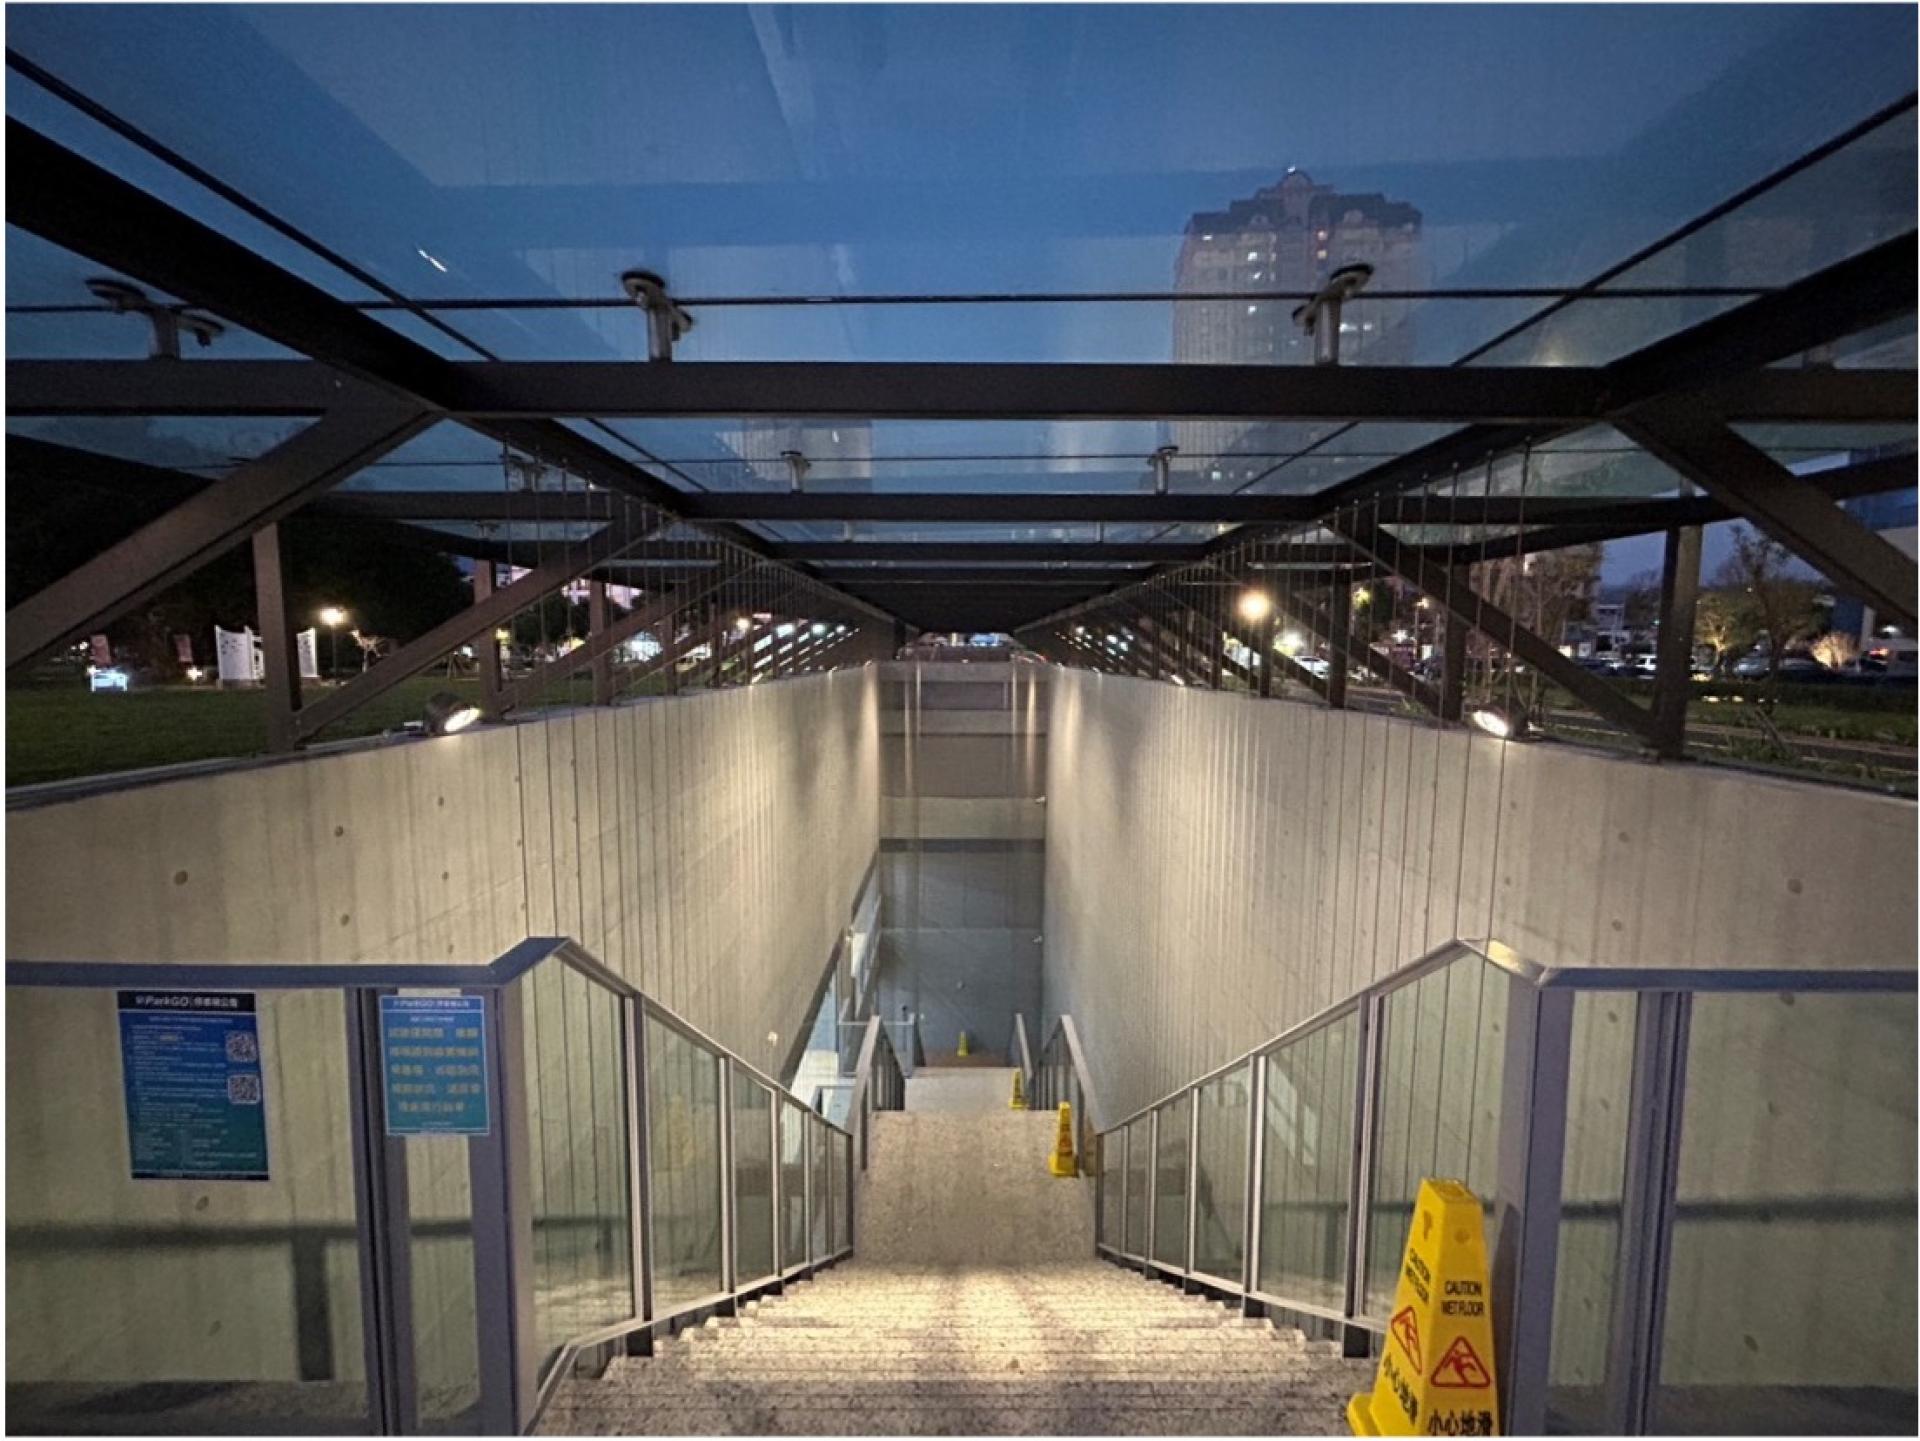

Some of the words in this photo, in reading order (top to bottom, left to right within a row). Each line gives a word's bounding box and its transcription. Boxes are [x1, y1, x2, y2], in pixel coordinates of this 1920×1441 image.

[145, 995, 189, 1007] ParkGO
[1445, 1280, 1482, 1296] CAUTION
[1441, 1301, 1457, 1316] WET
[1458, 1301, 1485, 1316] FLOOR
[1428, 1408, 1493, 1436] 小心地滑
